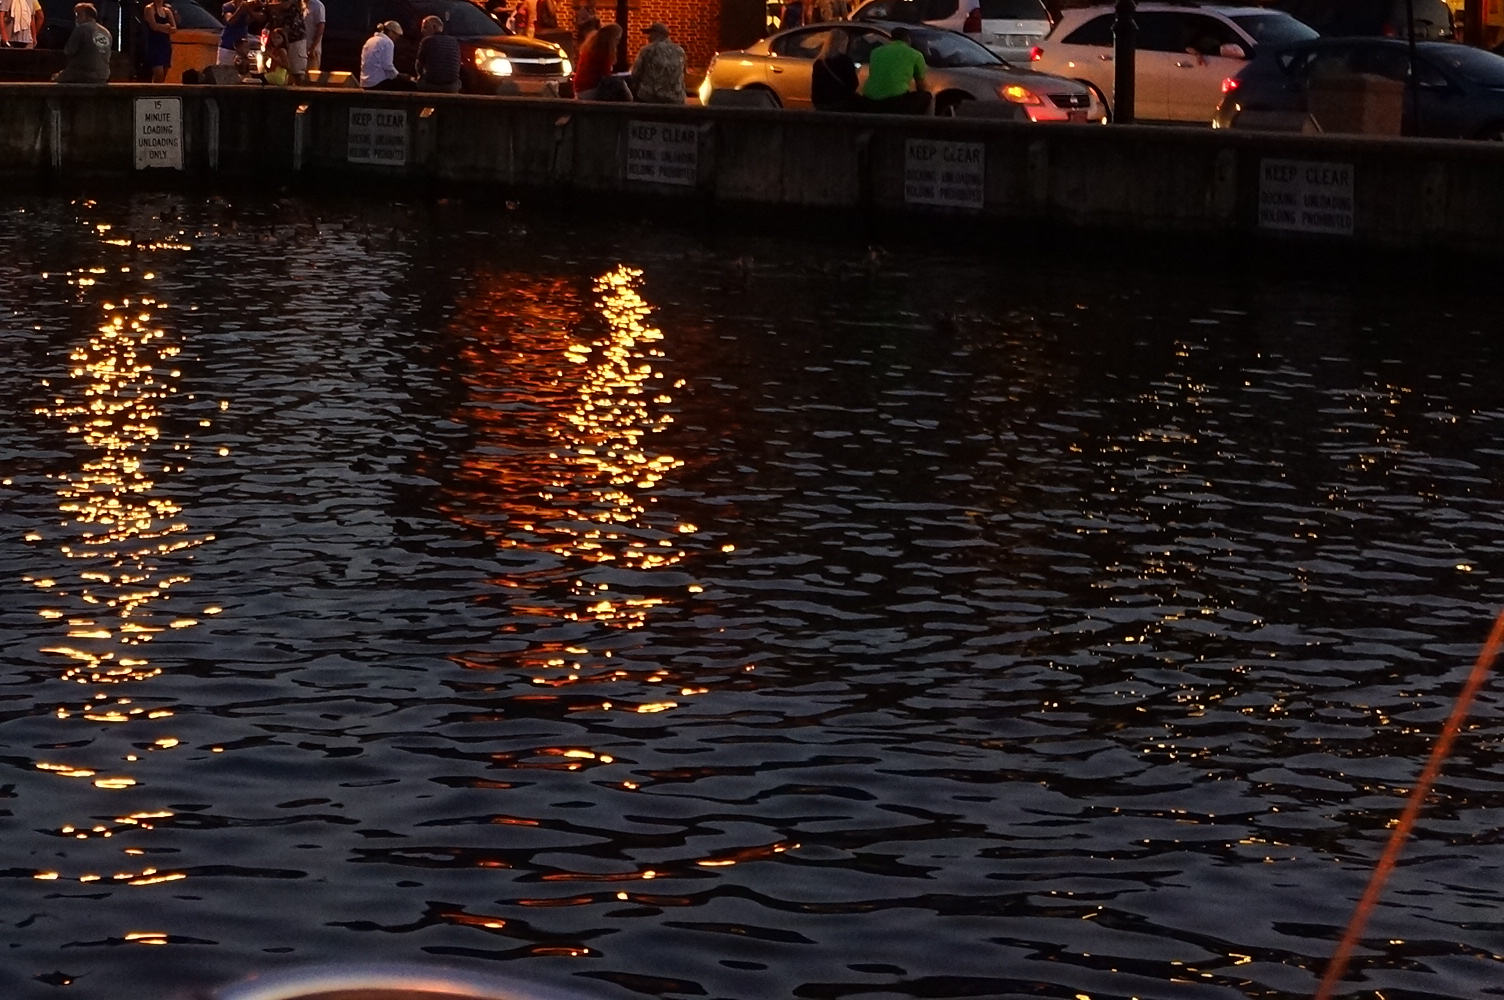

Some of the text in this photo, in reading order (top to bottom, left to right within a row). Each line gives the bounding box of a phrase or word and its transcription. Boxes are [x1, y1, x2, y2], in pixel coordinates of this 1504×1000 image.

[154, 101, 162, 110] 15
[145, 113, 171, 122] MINUTE
[352, 113, 404, 128] KEEP CLEAR
[143, 125, 173, 134] LOADING
[632, 126, 695, 143] KEEP CLEAR
[138, 138, 178, 147] UNLOADING
[149, 150, 167, 159] ONLY
[909, 145, 980, 163] KEEP CLEAR
[1265, 165, 1348, 185] KEEP CLEAR
